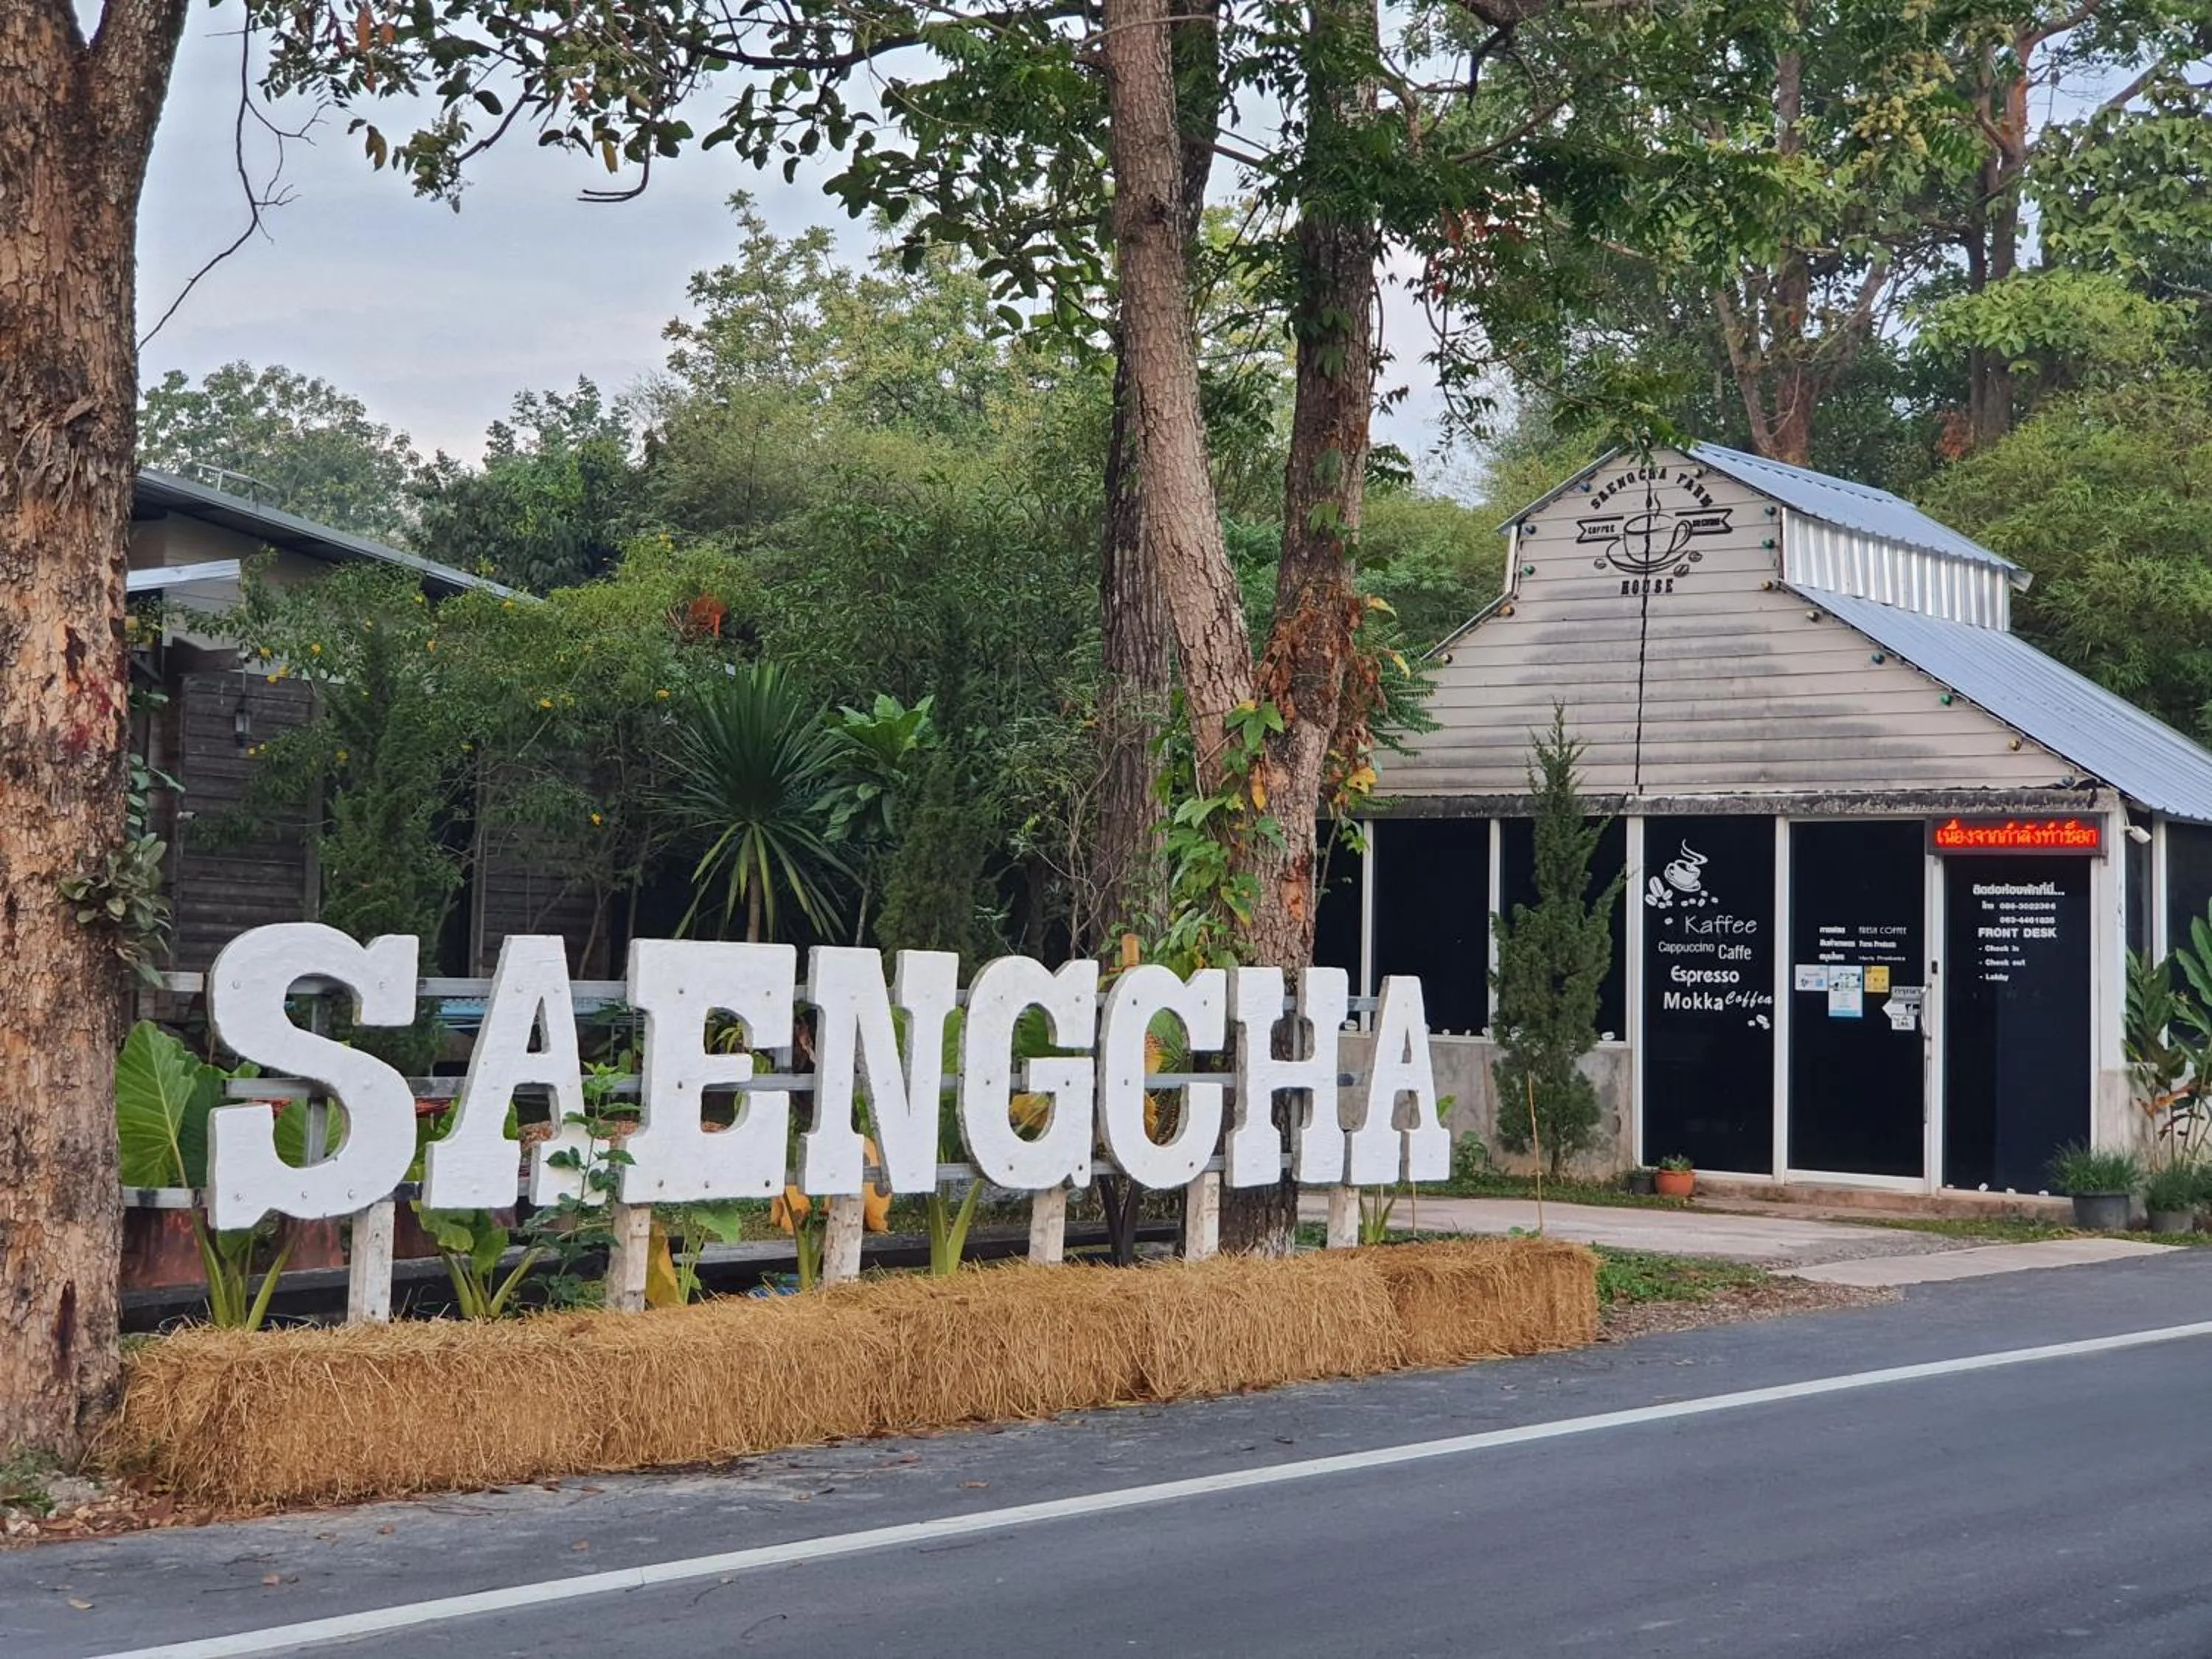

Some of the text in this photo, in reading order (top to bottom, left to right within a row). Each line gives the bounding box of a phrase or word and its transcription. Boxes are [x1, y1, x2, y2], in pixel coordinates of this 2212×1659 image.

[1676, 473, 1713, 507] FARM
[1621, 578, 1674, 595] HOUSE
[1685, 915, 1757, 933] Kaffee
[1978, 928, 2057, 938] FRONT DESK
[1658, 941, 1752, 960] Cappuccino Caffe
[1671, 965, 1740, 987] Espresso
[1663, 992, 1724, 1010] Mokka
[208, 922, 1451, 1230] SAENGCHA
